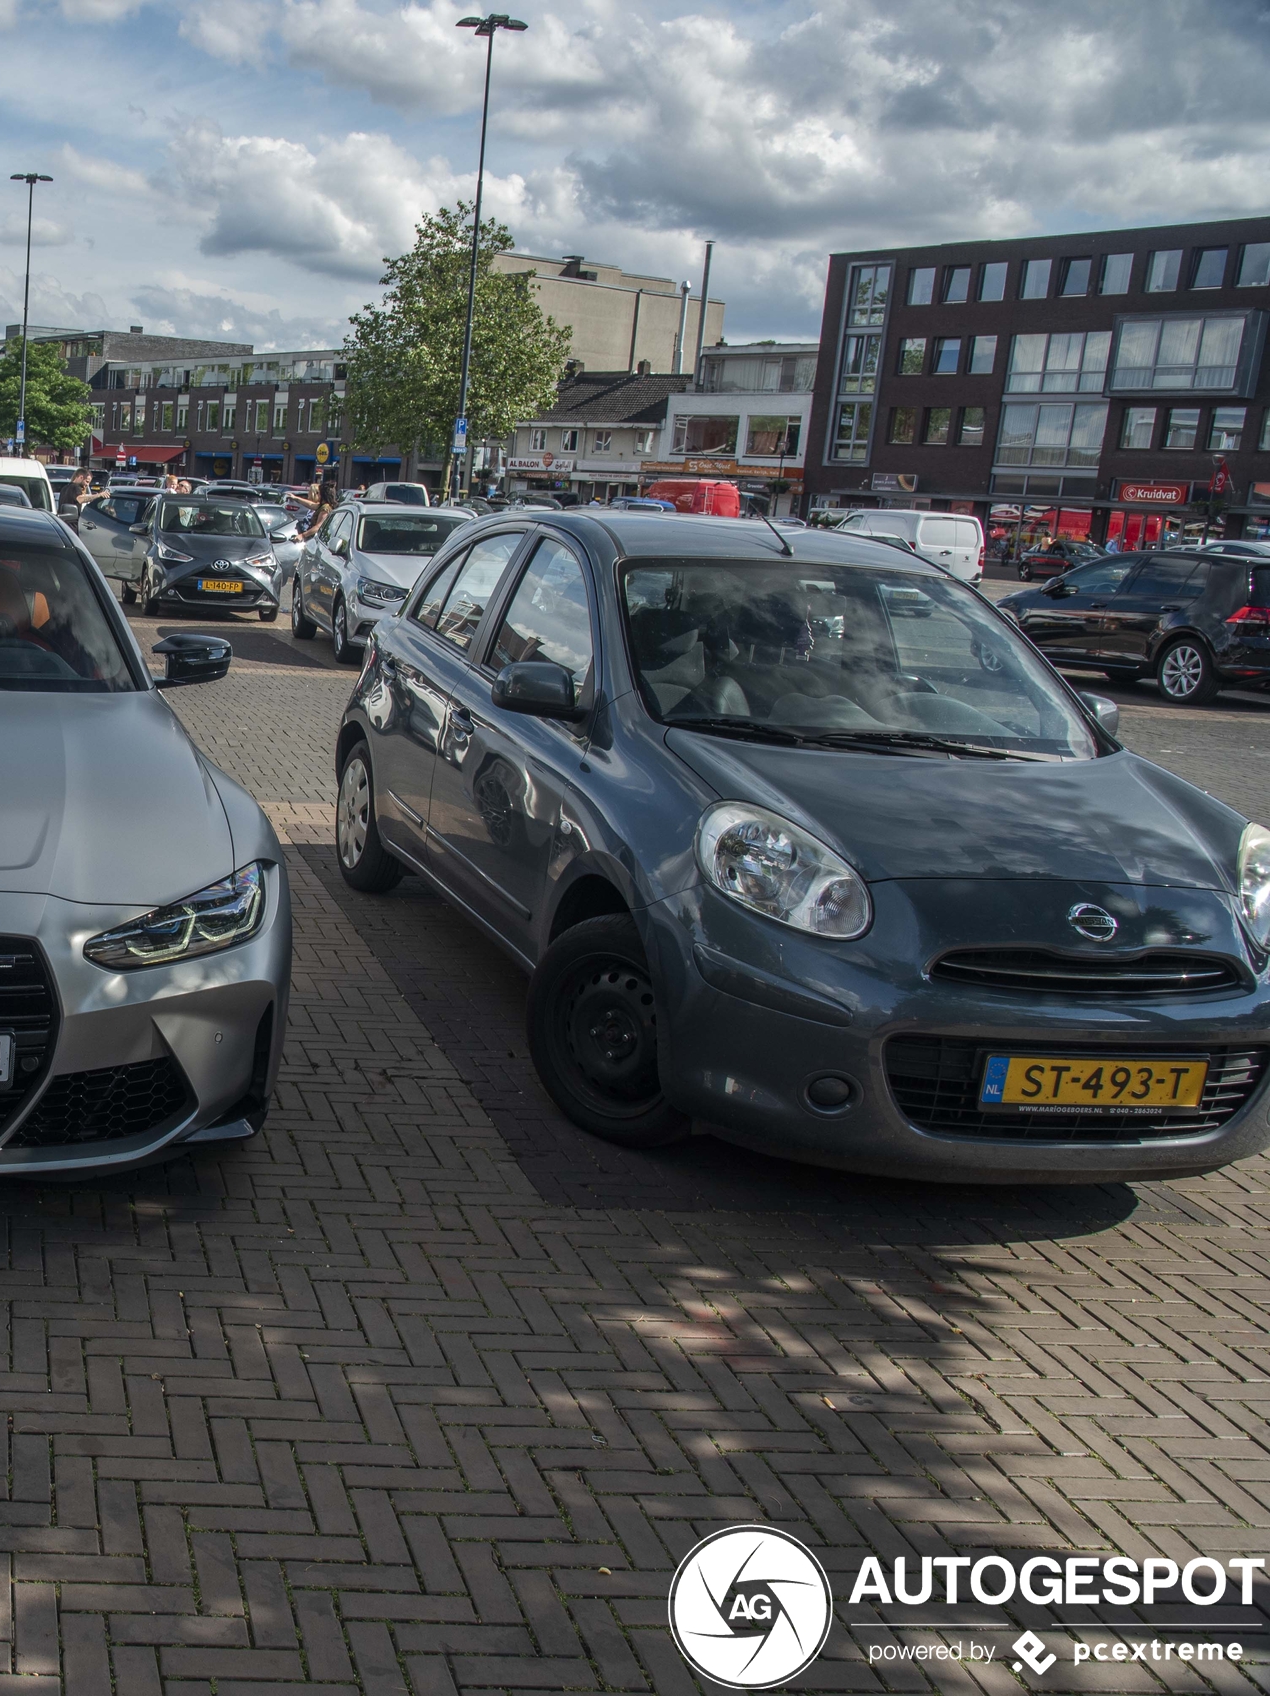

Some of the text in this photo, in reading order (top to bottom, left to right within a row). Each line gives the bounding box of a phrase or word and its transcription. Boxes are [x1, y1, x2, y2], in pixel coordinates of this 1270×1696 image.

[459, 420, 465, 429] P
[1137, 489, 1176, 499] Kruidvat
[206, 581, 239, 590] L-140-FP
[1021, 1064, 1189, 1099] ST-493-T
[985, 1083, 1001, 1095] NL
